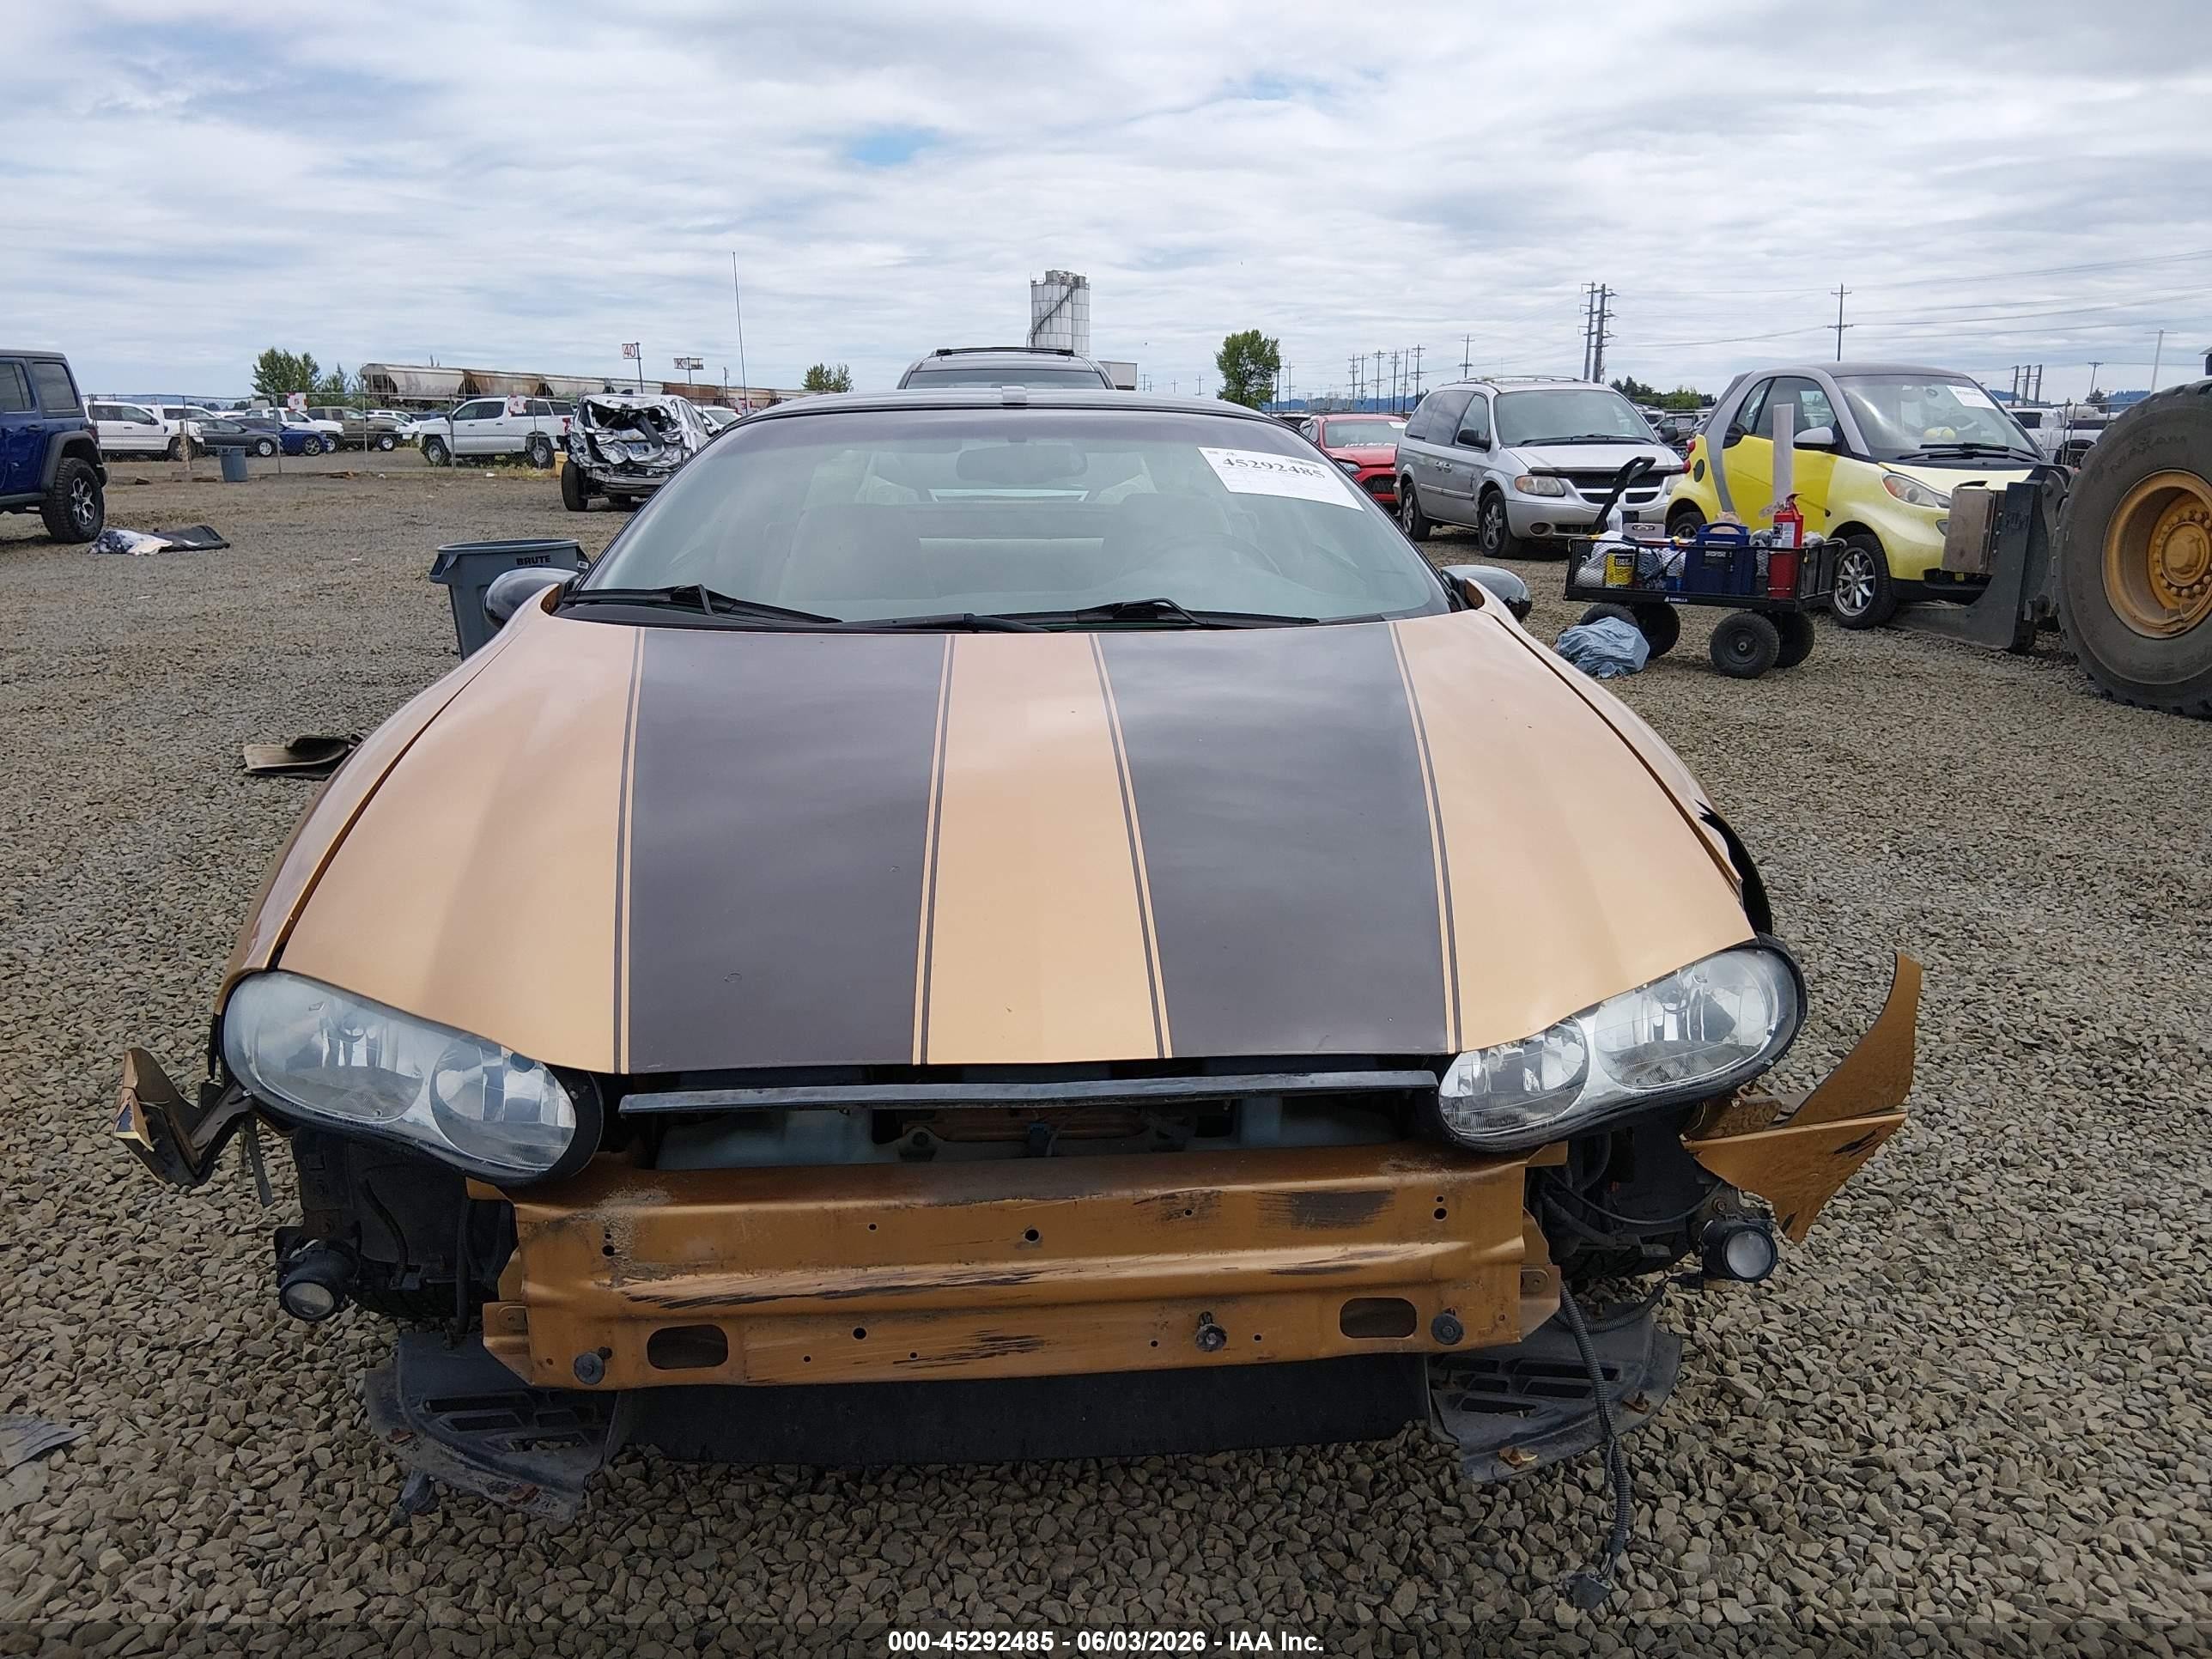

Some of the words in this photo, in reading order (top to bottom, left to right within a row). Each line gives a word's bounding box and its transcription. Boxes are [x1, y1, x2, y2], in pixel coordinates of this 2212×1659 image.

[623, 344, 636, 357] 40
[1223, 458, 1325, 479] 45292485
[516, 555, 551, 566] BRUTE
